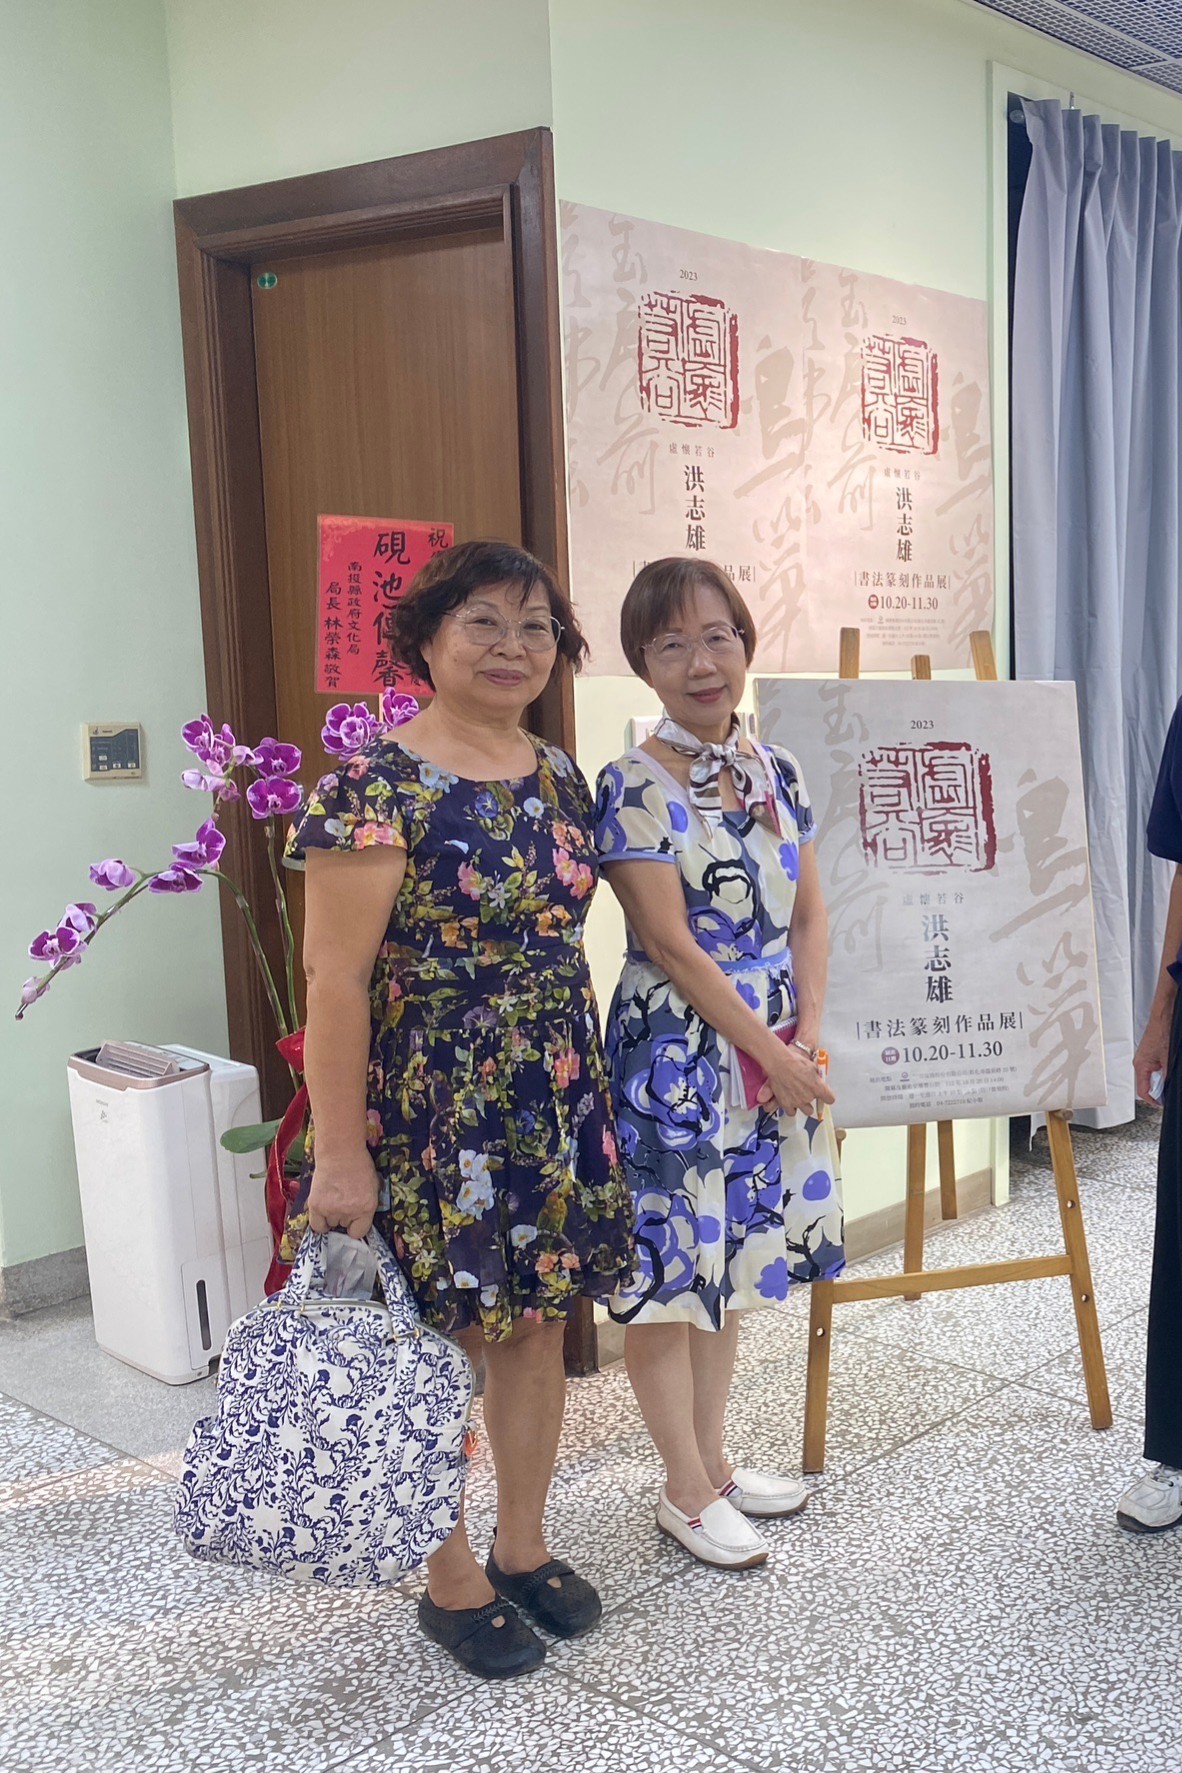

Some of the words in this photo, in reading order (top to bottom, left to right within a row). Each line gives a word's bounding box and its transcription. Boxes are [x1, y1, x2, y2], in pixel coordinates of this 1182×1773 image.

[680, 269, 698, 281] 2023
[892, 315, 907, 326] 2023
[684, 465, 706, 551] 洪志雄
[896, 487, 913, 562] 洪志雄
[860, 571, 947, 589] 書法篆刻作品展
[347, 561, 363, 655] 南投縣政府文化局
[881, 596, 939, 610] 10.20-11.30
[910, 720, 935, 730] 2023
[921, 914, 954, 1004] 洪志雄
[864, 1011, 1017, 1040] 書法篆刻作品展
[903, 1041, 1003, 1063] 10.20-11.30
